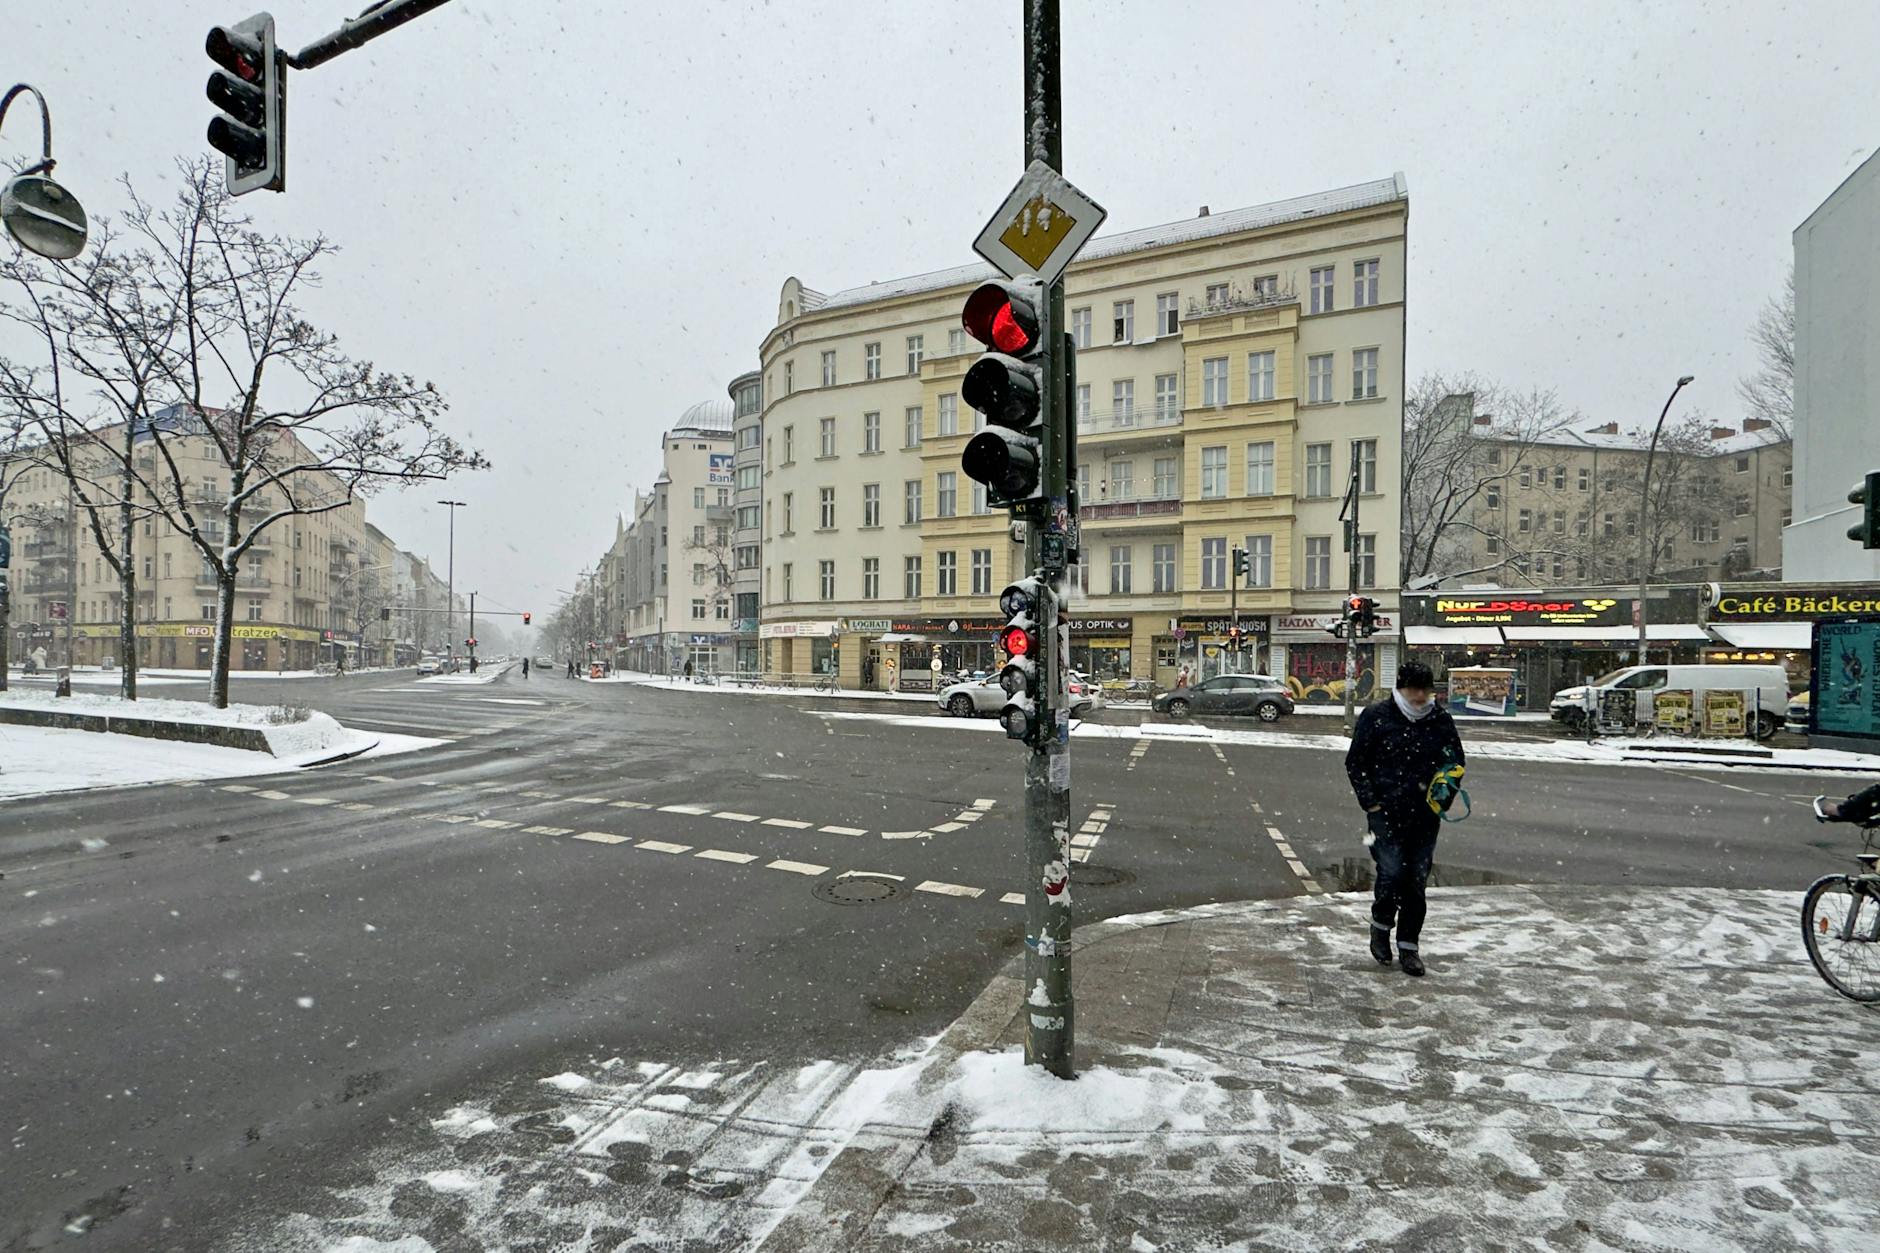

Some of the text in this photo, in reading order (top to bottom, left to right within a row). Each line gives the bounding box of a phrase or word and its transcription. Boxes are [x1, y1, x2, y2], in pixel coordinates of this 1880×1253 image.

[710, 473, 735, 482] Bank
[1437, 600, 1575, 612] Nur Döner
[1718, 597, 1776, 614] Café
[1086, 621, 1114, 629] OPTIK
[1240, 621, 1267, 631] KIOSK
[1278, 618, 1316, 628] HATAY
[186, 628, 209, 636] MFO
[212, 627, 278, 637] tratzen
[1822, 626, 1862, 636] WORLD
[1821, 637, 1832, 656] THE
